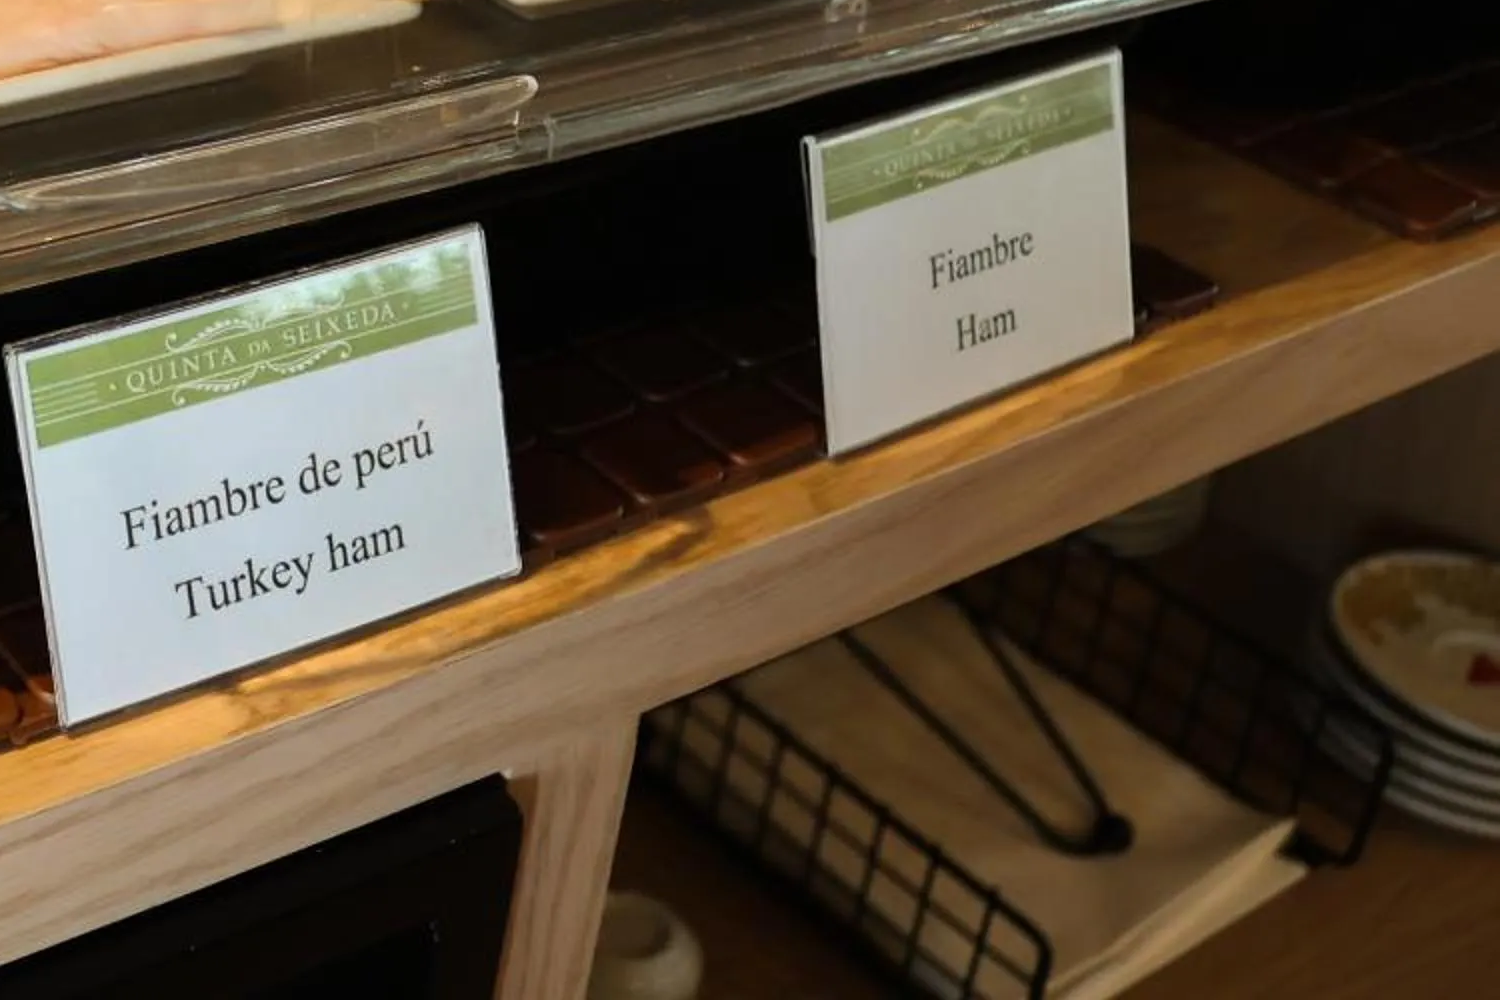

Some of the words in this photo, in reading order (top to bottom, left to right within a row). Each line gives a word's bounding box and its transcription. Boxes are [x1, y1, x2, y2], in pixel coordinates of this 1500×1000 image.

[929, 231, 1034, 289] Fiambre
[125, 346, 236, 394] QUINTA
[282, 300, 396, 348] SEIXEDA
[956, 307, 1017, 351] Ham
[120, 473, 285, 550] Fiambre
[298, 453, 342, 494] de
[354, 419, 433, 490] perú
[175, 552, 315, 619] Turkey
[326, 521, 405, 572] ham
